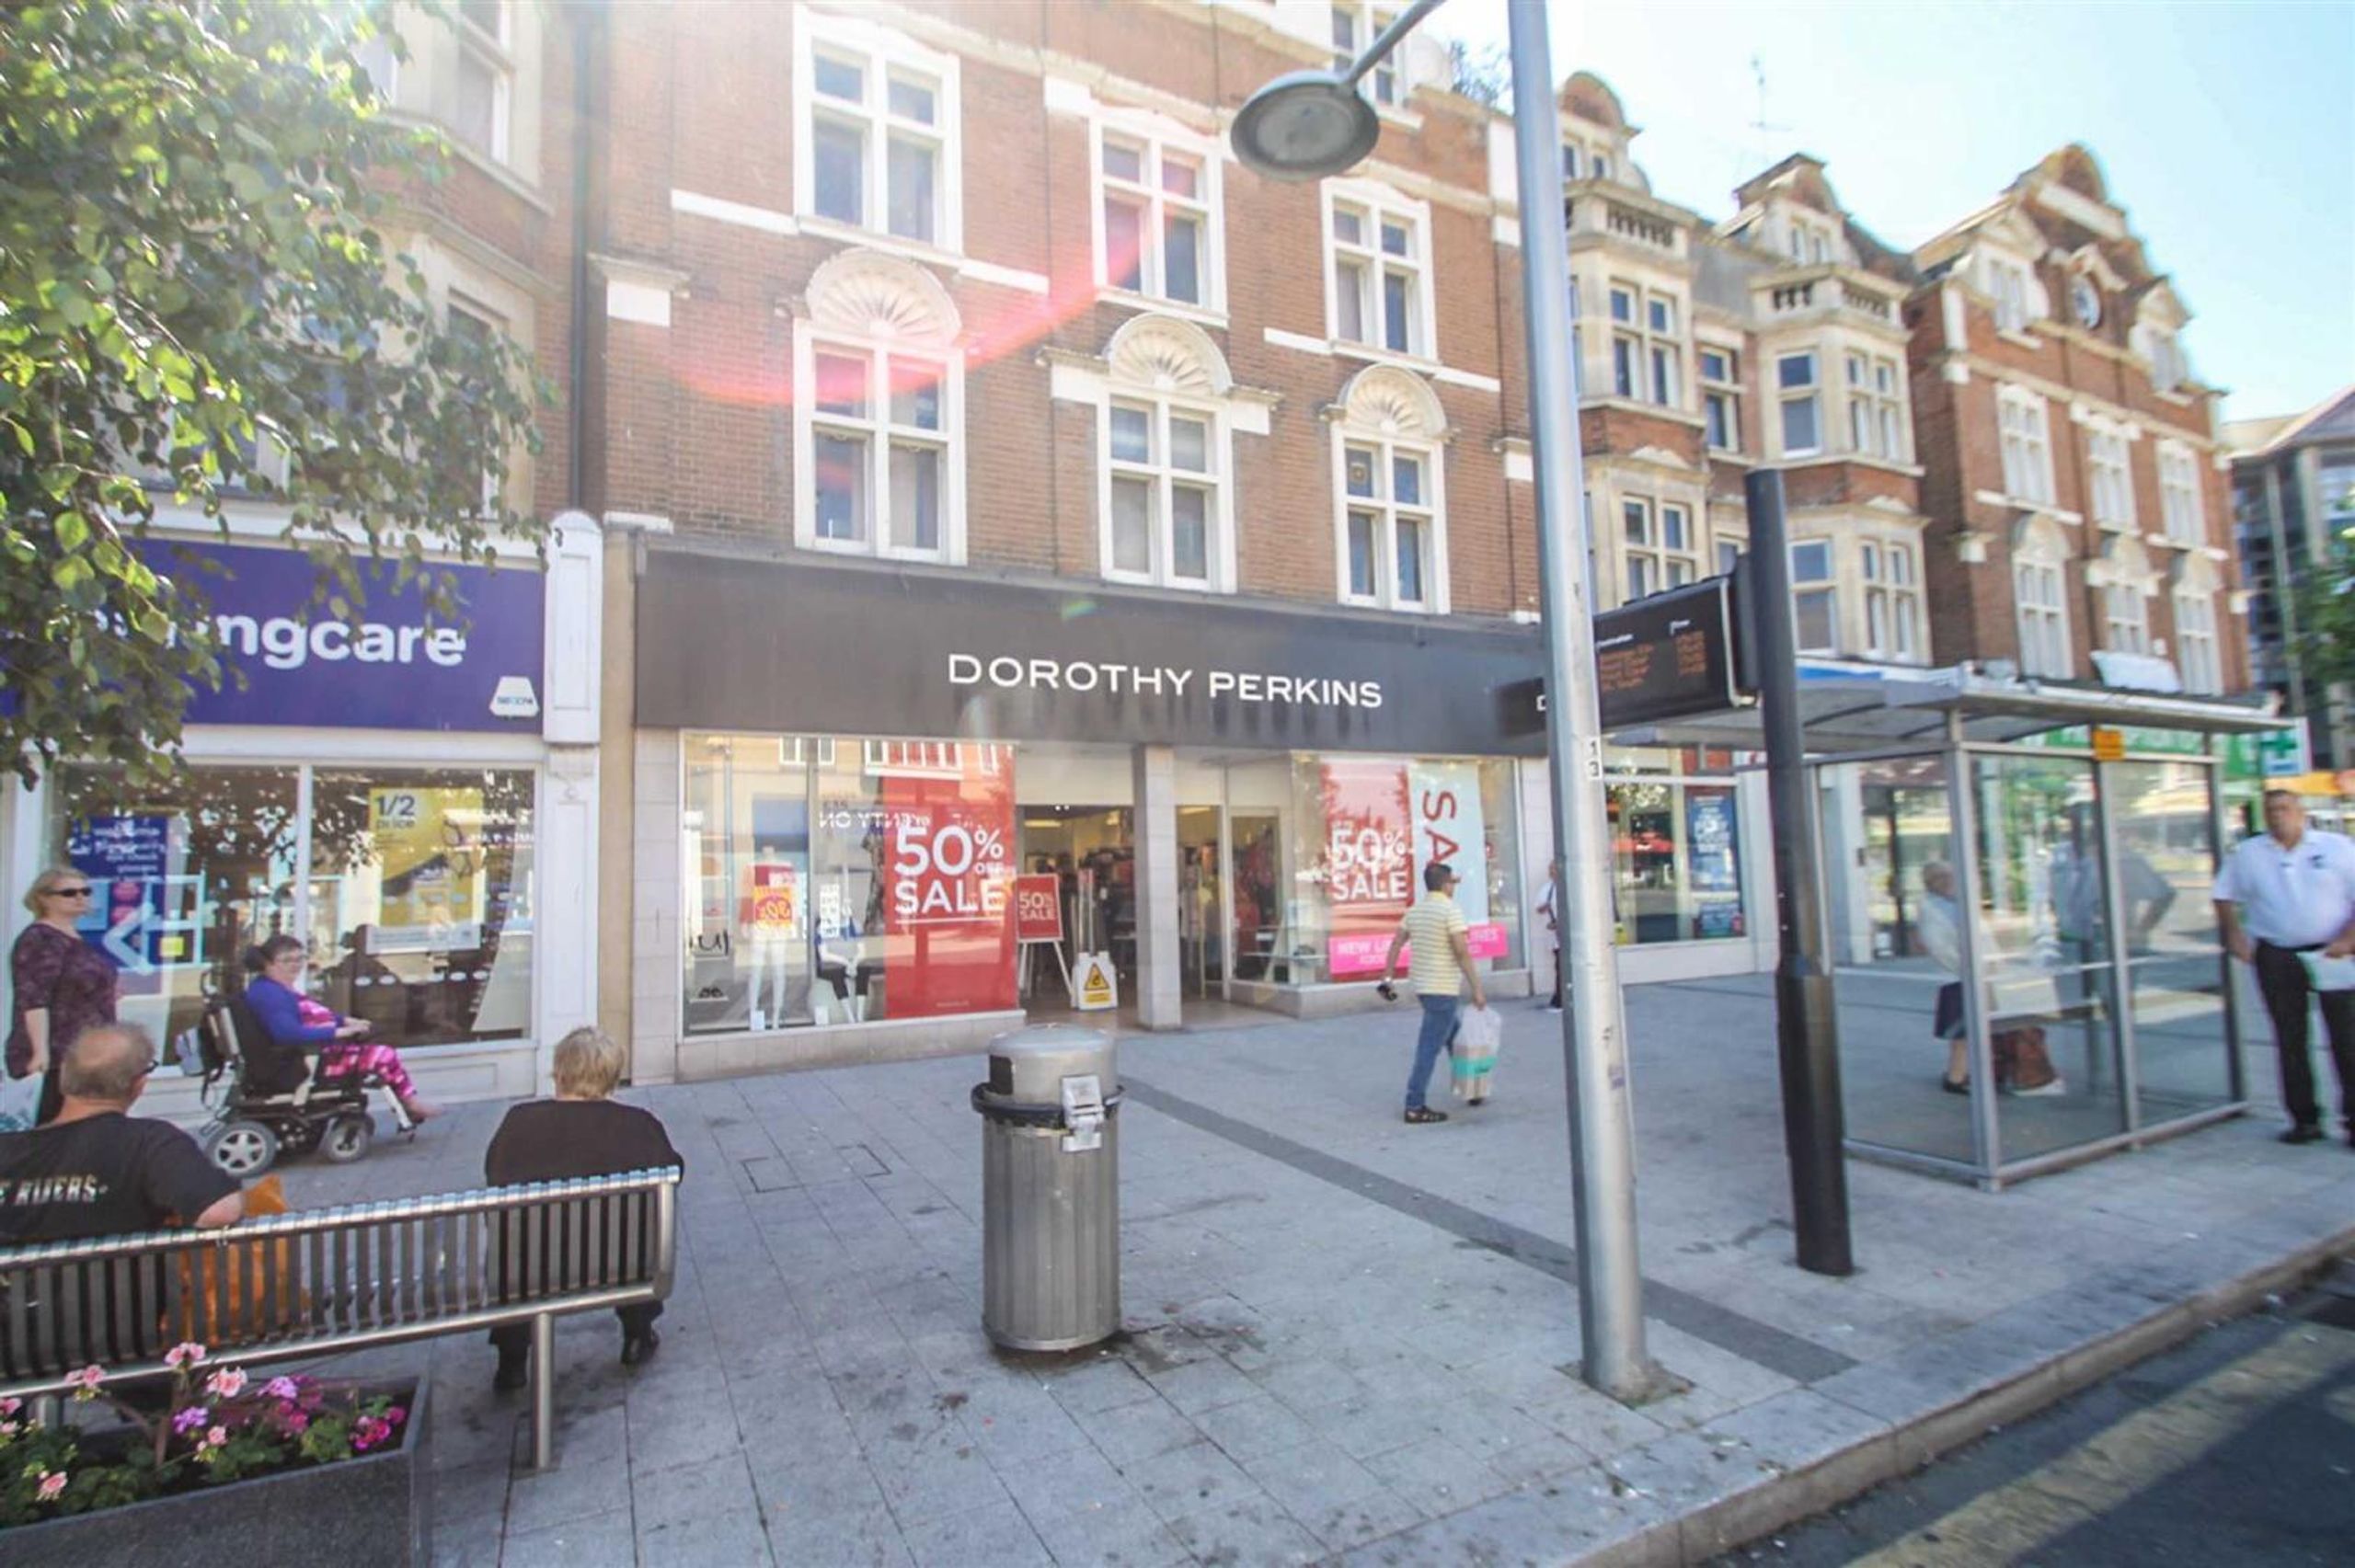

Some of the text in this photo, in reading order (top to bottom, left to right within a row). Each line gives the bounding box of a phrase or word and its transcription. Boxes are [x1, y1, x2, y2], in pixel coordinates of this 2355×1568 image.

[948, 654, 1383, 708] DOROTHY PERKINS
[375, 795, 415, 817] 1/2
[1423, 789, 1459, 863] SA
[894, 825, 1005, 876] 50%
[1331, 828, 1407, 870] 50%
[894, 879, 1005, 914] SALE
[1331, 873, 1408, 900] SALE
[1019, 909, 1056, 921] SALE
